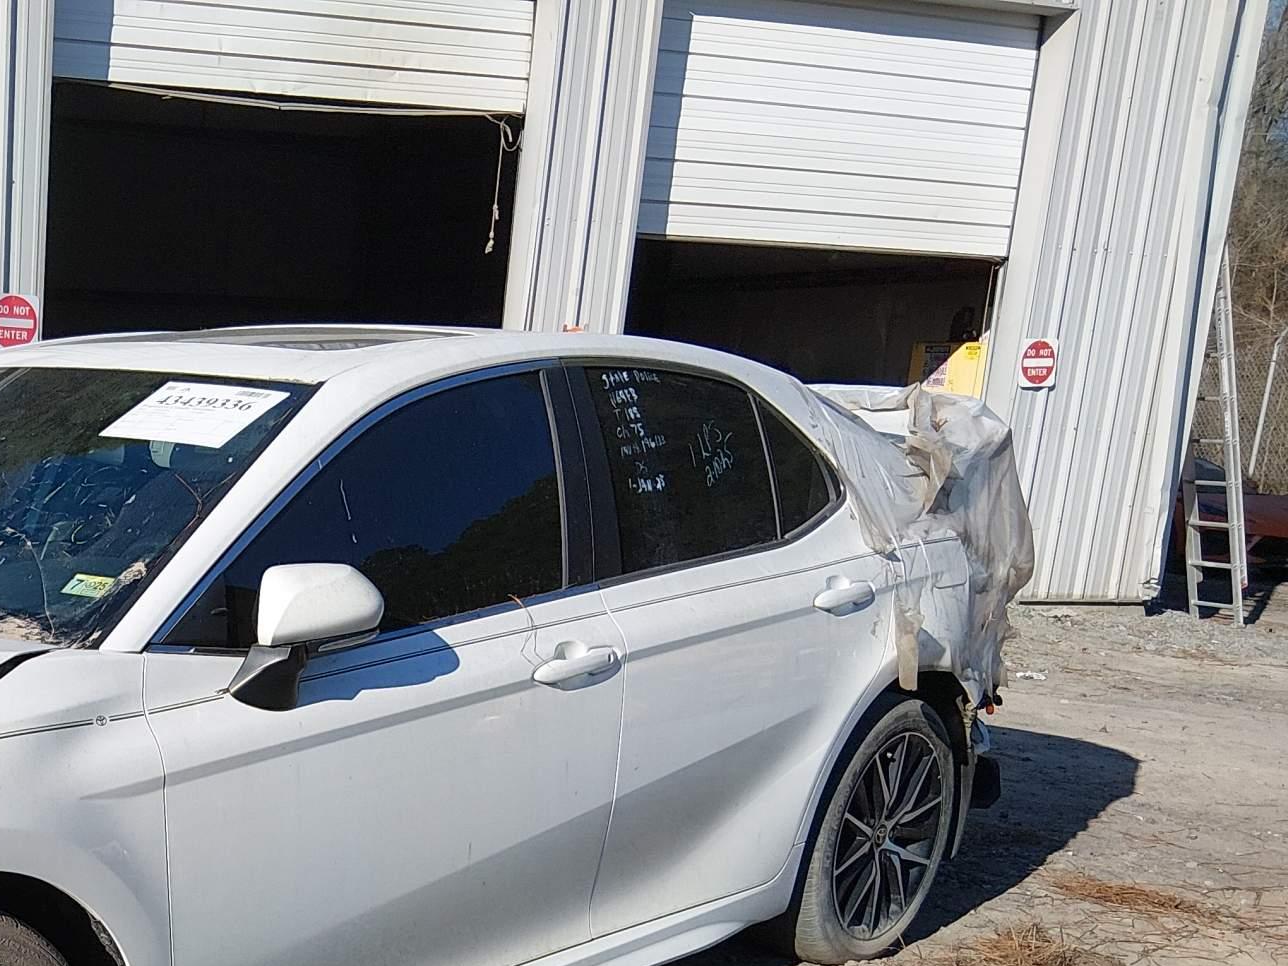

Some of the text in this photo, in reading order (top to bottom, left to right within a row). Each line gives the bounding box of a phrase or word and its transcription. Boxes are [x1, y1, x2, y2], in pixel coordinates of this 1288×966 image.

[13, 306, 31, 316] NOT
[1026, 348, 1052, 357] DO NOT
[1027, 368, 1048, 377] ENTER
[156, 395, 257, 411] 43439336
[70, 579, 86, 590] 7
